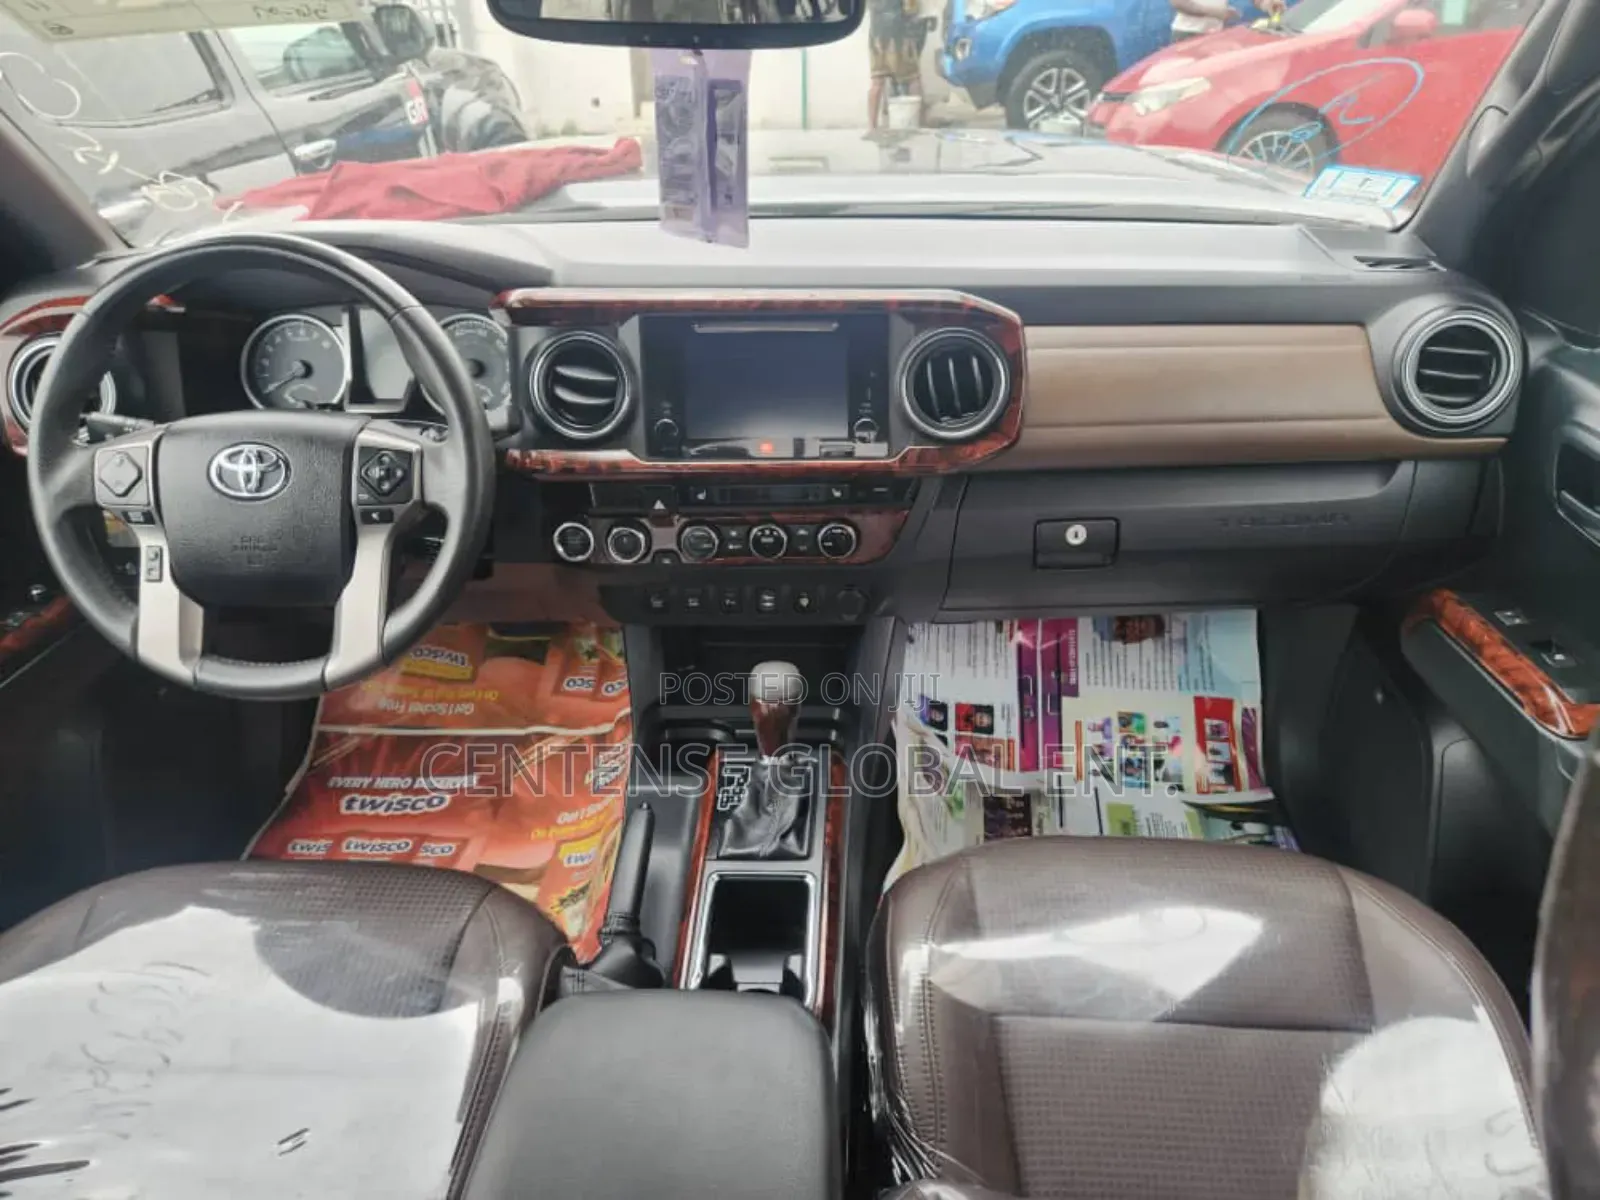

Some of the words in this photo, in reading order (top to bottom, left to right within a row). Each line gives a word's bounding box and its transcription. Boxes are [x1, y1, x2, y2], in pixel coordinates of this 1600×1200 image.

[411, 646, 469, 668] twisco
[340, 792, 451, 815] twisco
[341, 837, 413, 854] twisco
